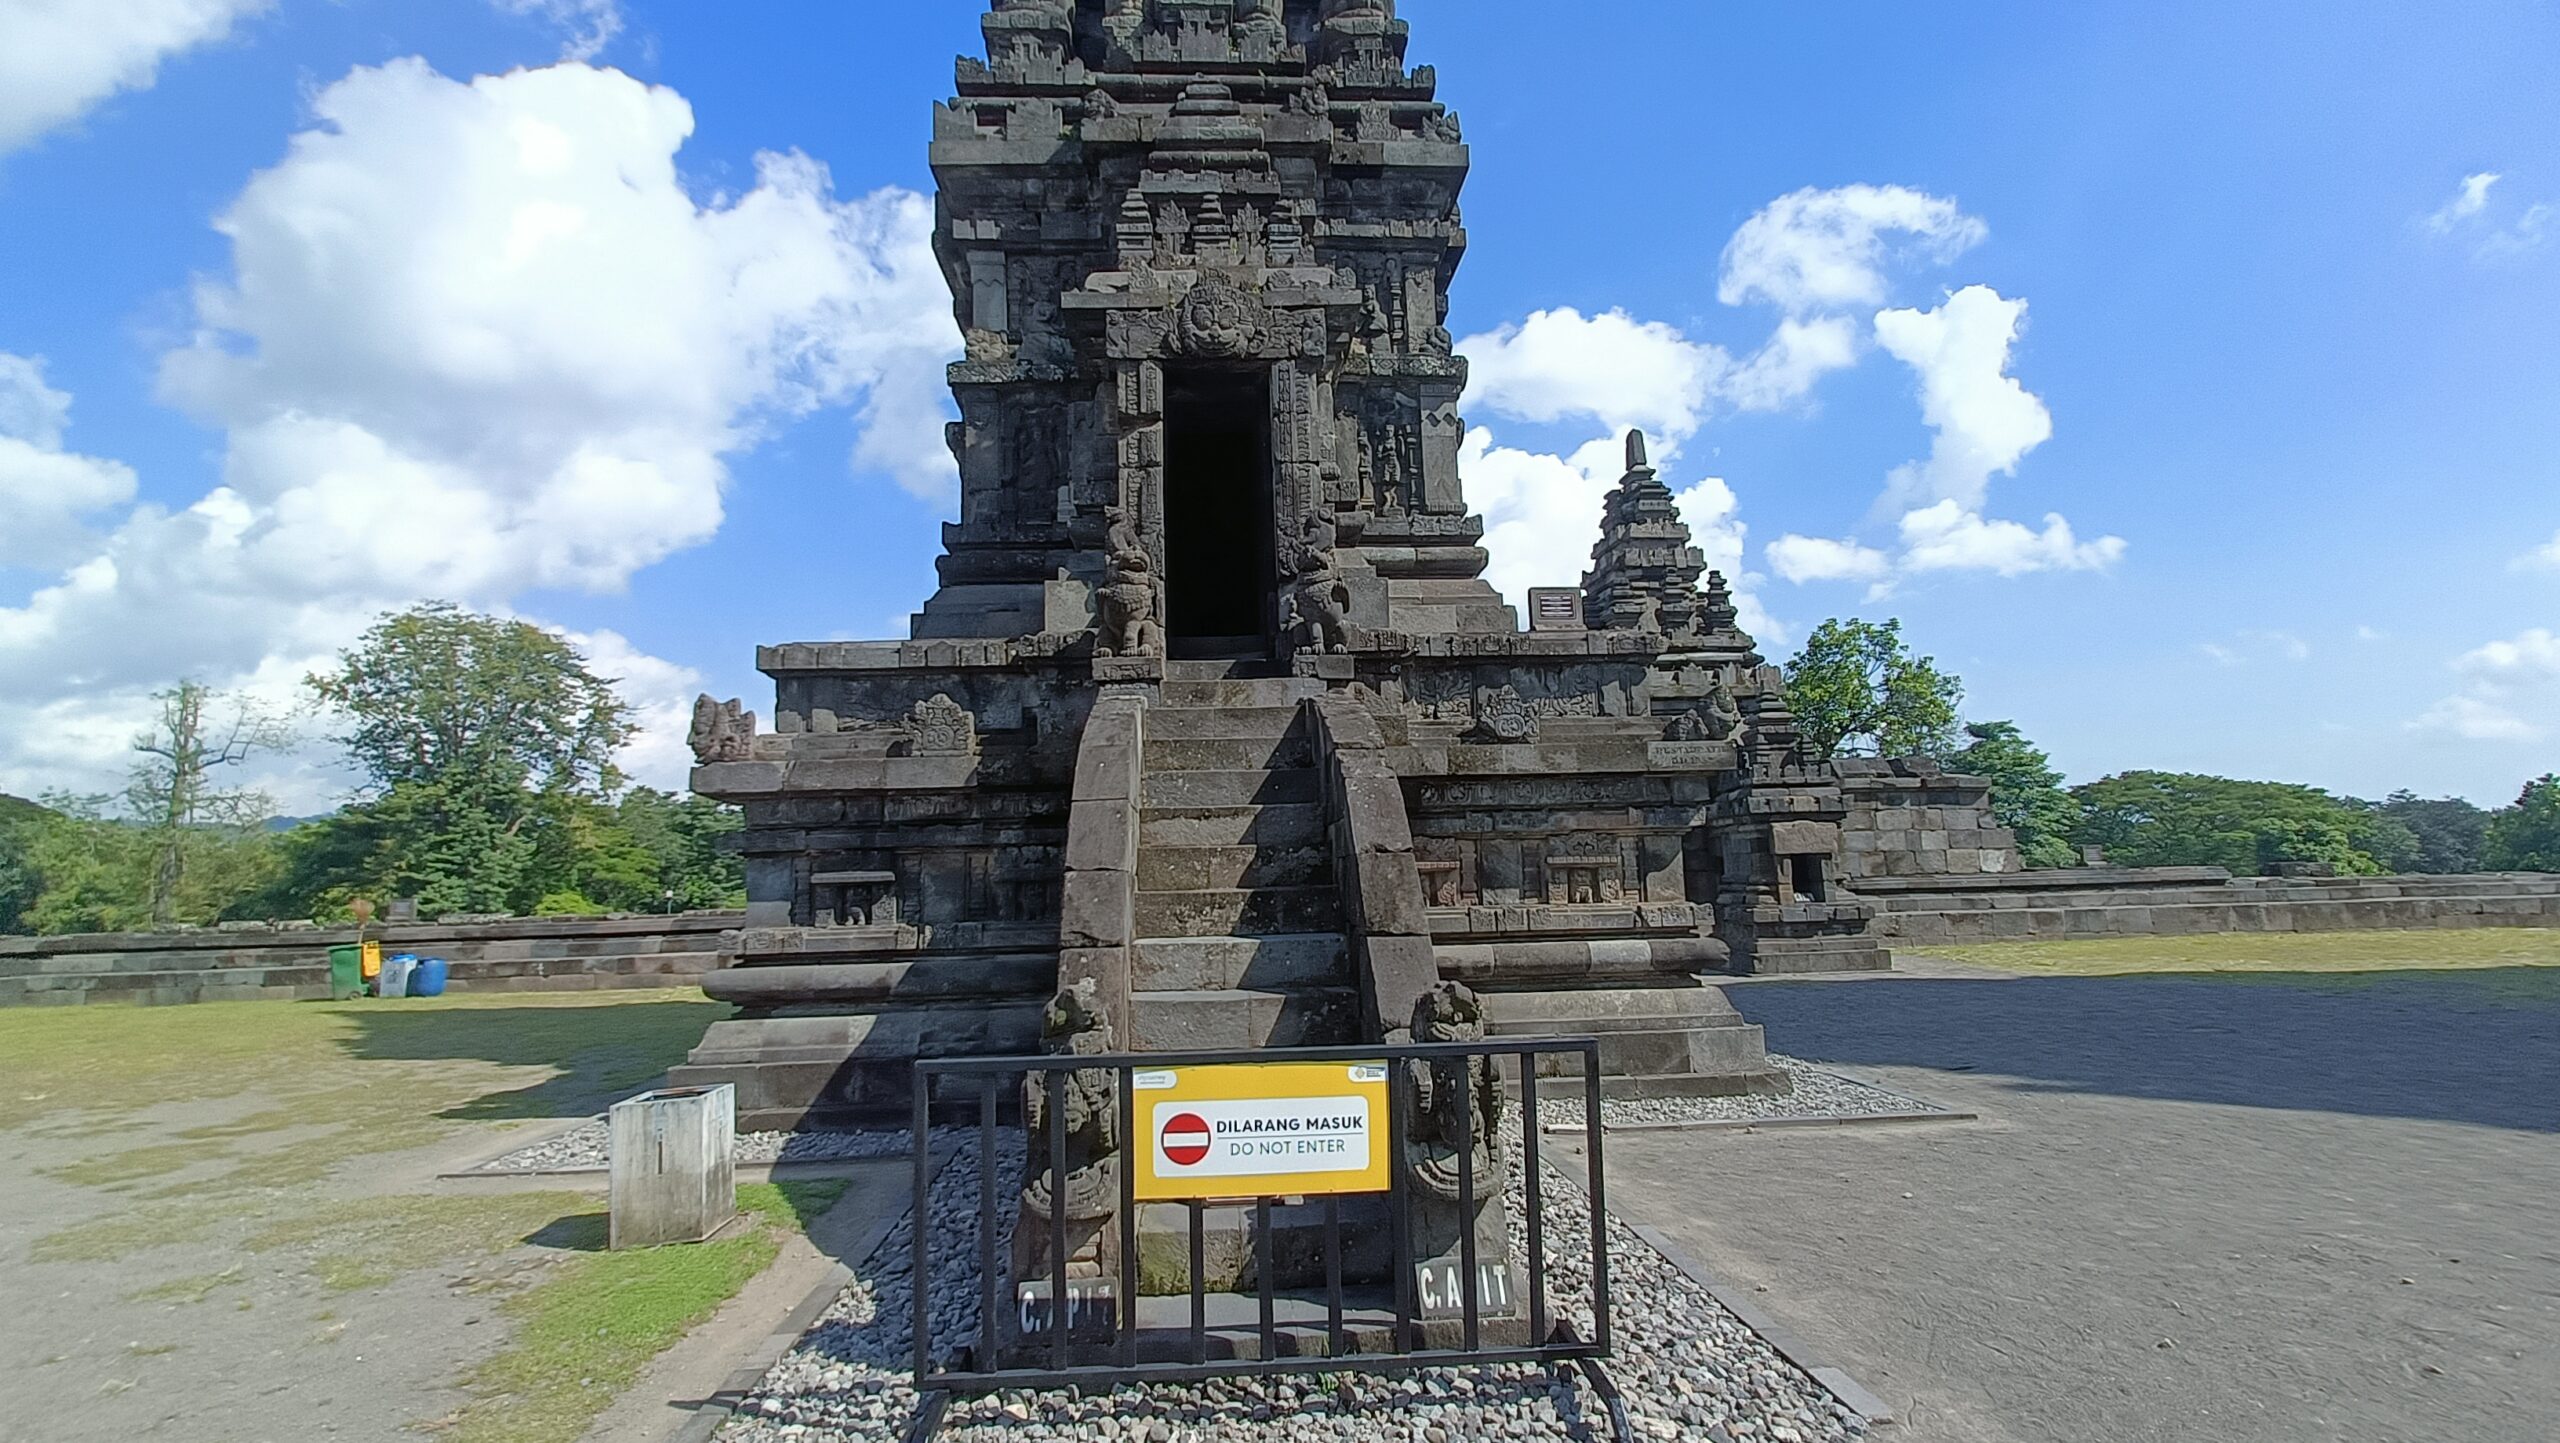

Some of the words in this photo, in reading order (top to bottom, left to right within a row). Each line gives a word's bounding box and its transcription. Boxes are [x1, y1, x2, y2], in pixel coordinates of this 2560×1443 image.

[1216, 1118, 1300, 1133] DILARANG
[1306, 1116, 1363, 1130] MASUK
[1230, 1141, 1254, 1156] DO
[1260, 1140, 1292, 1155] NOT
[1298, 1139, 1346, 1154] ENTER
[1446, 1265, 1507, 1308] AIT
